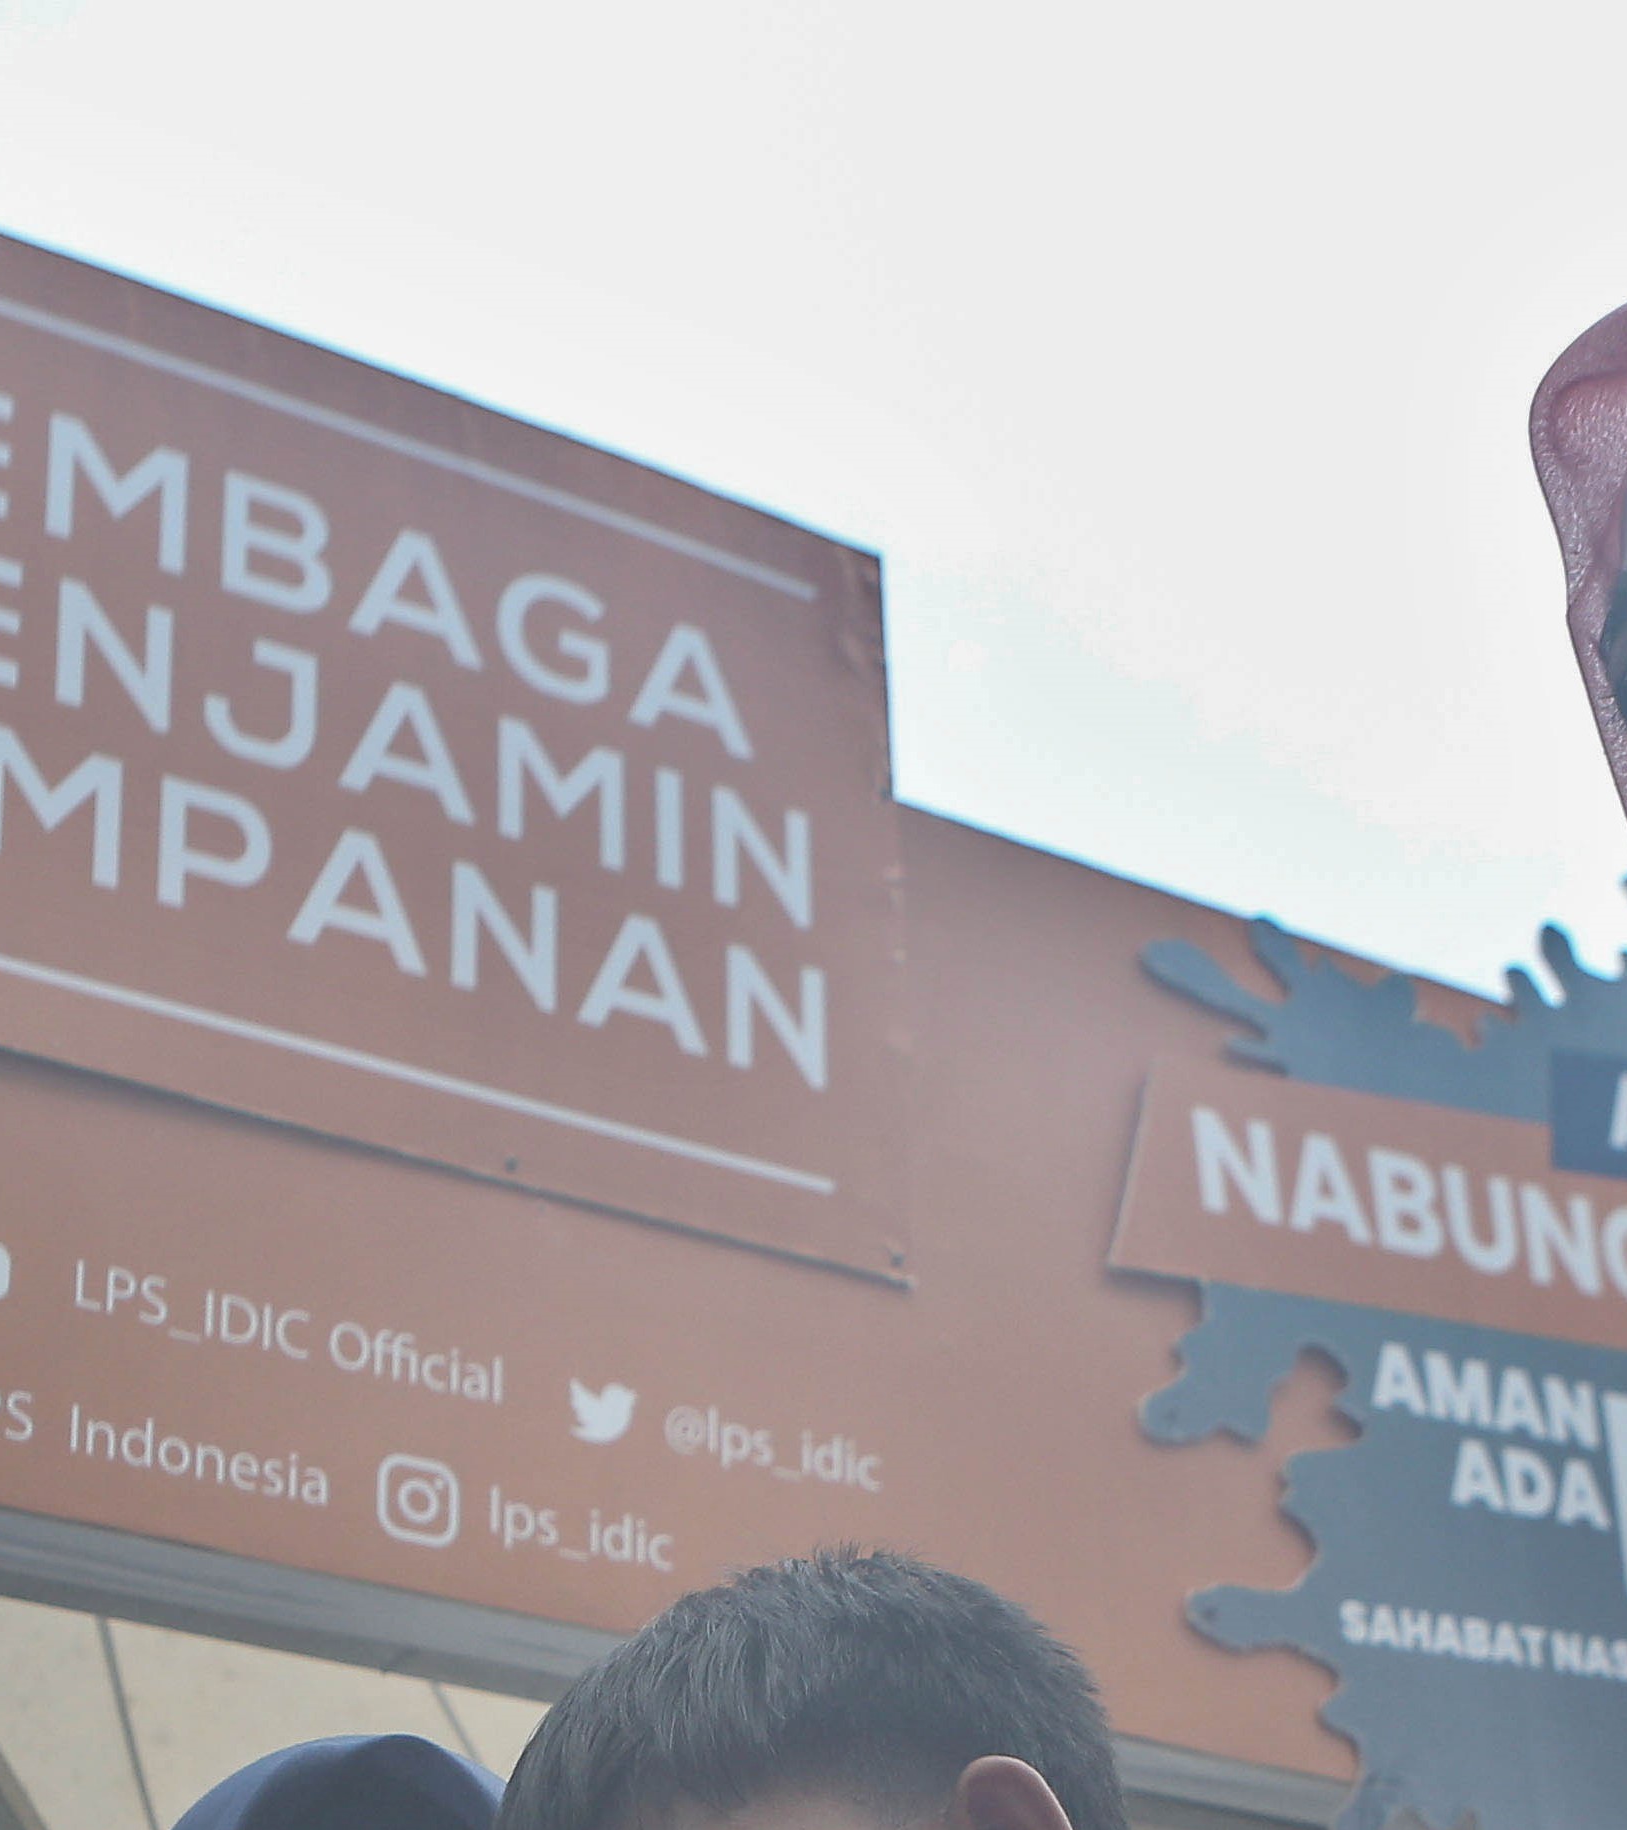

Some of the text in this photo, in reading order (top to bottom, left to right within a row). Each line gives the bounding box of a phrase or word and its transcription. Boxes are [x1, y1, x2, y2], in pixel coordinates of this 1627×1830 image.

[74, 1258, 505, 1405] LPS_IDIC Official
[1374, 1341, 1602, 1451] AMAN
[68, 1402, 329, 1508] Indonesia
[662, 1405, 882, 1493] @lps_idic
[1450, 1441, 1611, 1532] ADA
[487, 1485, 675, 1572] lps_idic
[1340, 1599, 1548, 1672] SAHABAT
